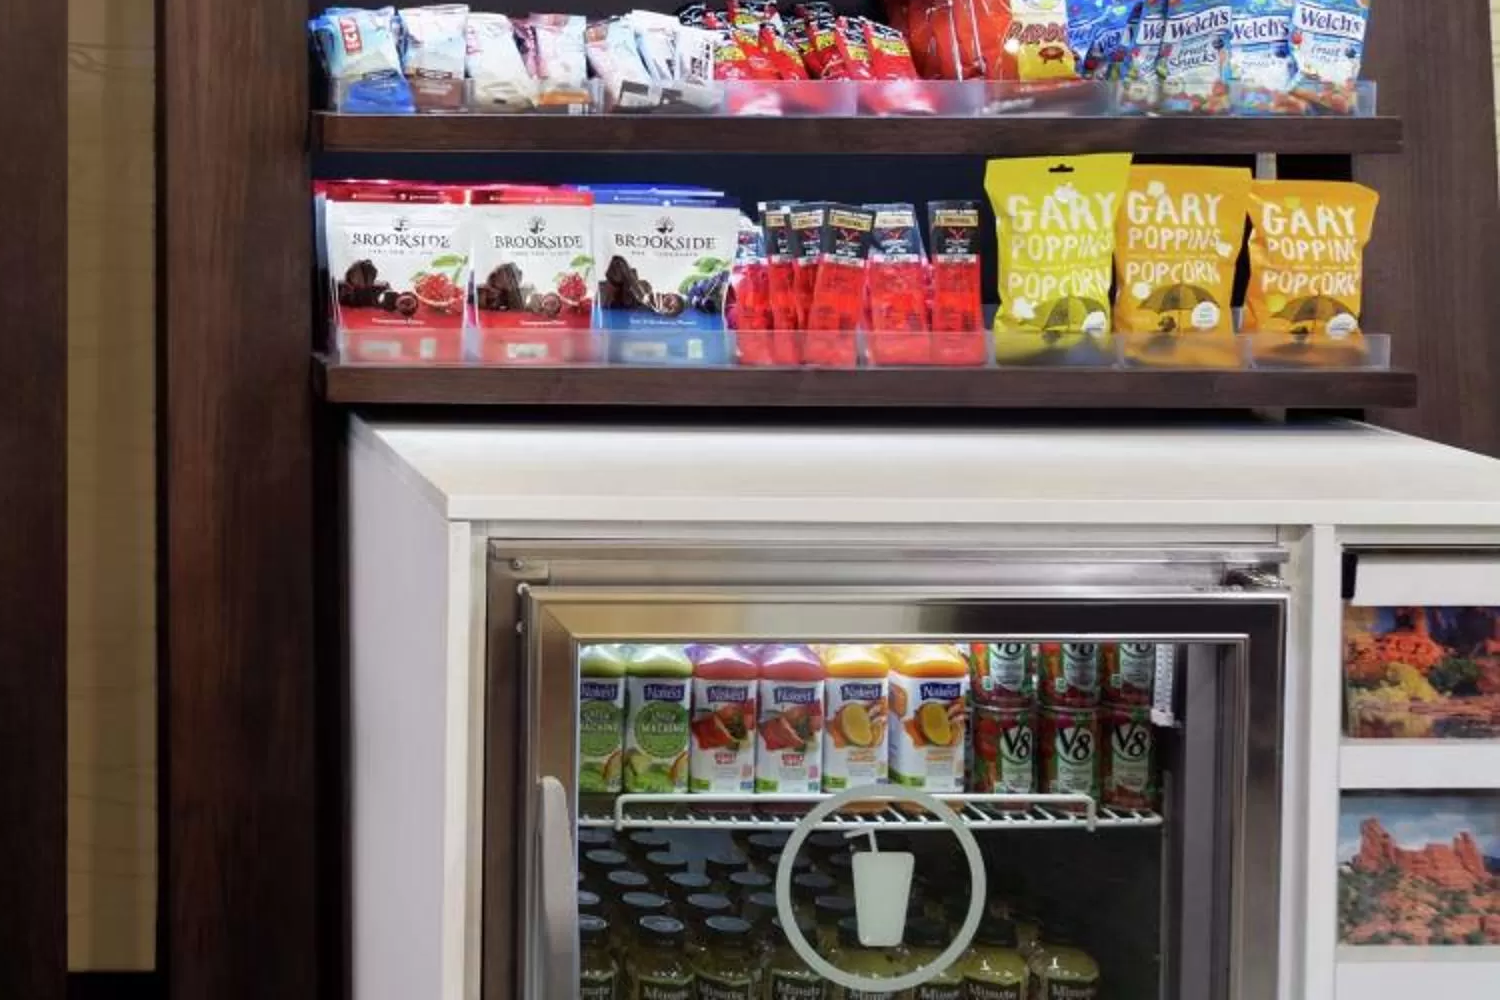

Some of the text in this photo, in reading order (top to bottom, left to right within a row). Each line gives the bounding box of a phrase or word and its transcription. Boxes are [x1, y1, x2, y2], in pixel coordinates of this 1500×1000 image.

[1169, 7, 1230, 39] Welch's
[1232, 17, 1290, 40] Welch's
[1300, 7, 1363, 35] Welch's
[1007, 191, 1116, 234] GARY
[1126, 190, 1224, 226] GARY
[1262, 201, 1356, 237] GARY
[351, 233, 451, 250] BROOKSIDE
[494, 234, 584, 250] BROOKSIDE
[614, 233, 717, 251] BROOKSIDE
[1128, 226, 1222, 251] POPPINS
[1007, 266, 1112, 301] POPCORN
[1125, 259, 1221, 285] POPCORN
[1261, 270, 1357, 297] POPCORN
[710, 686, 747, 700] Naked
[844, 684, 881, 699] Naked
[1001, 727, 1032, 758] V8
[1057, 729, 1093, 761] V8
[1113, 725, 1149, 759] V8
